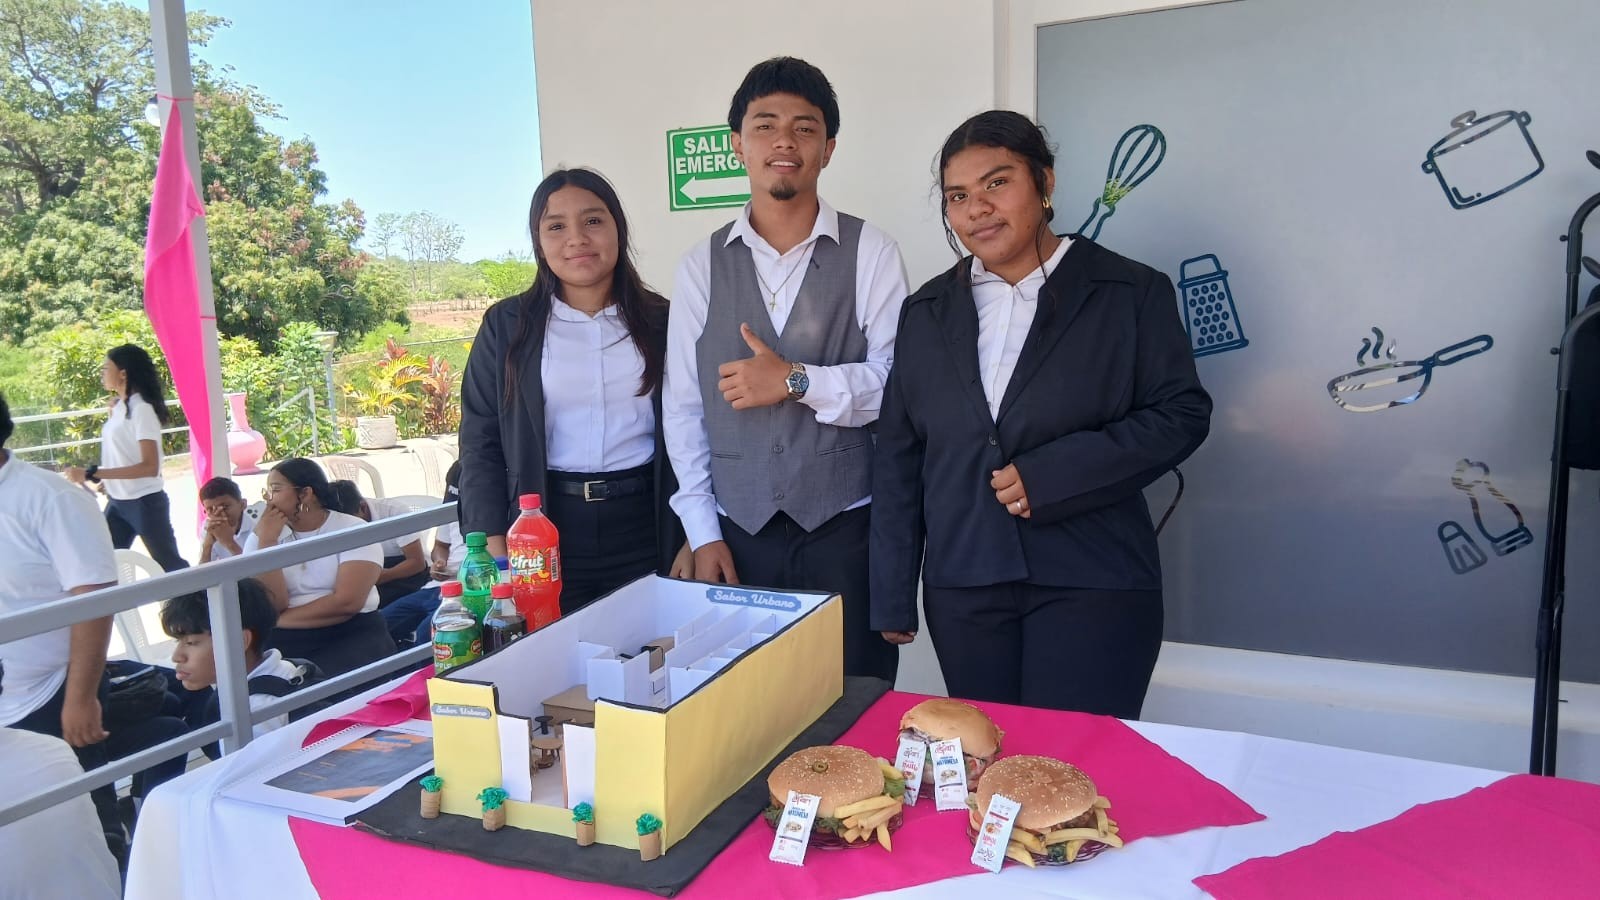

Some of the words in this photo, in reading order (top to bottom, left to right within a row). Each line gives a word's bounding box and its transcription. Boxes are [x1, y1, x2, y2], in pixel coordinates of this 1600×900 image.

[675, 152, 745, 175] EMERG
[713, 590, 748, 603] Sabor
[750, 593, 796, 609] Urbano
